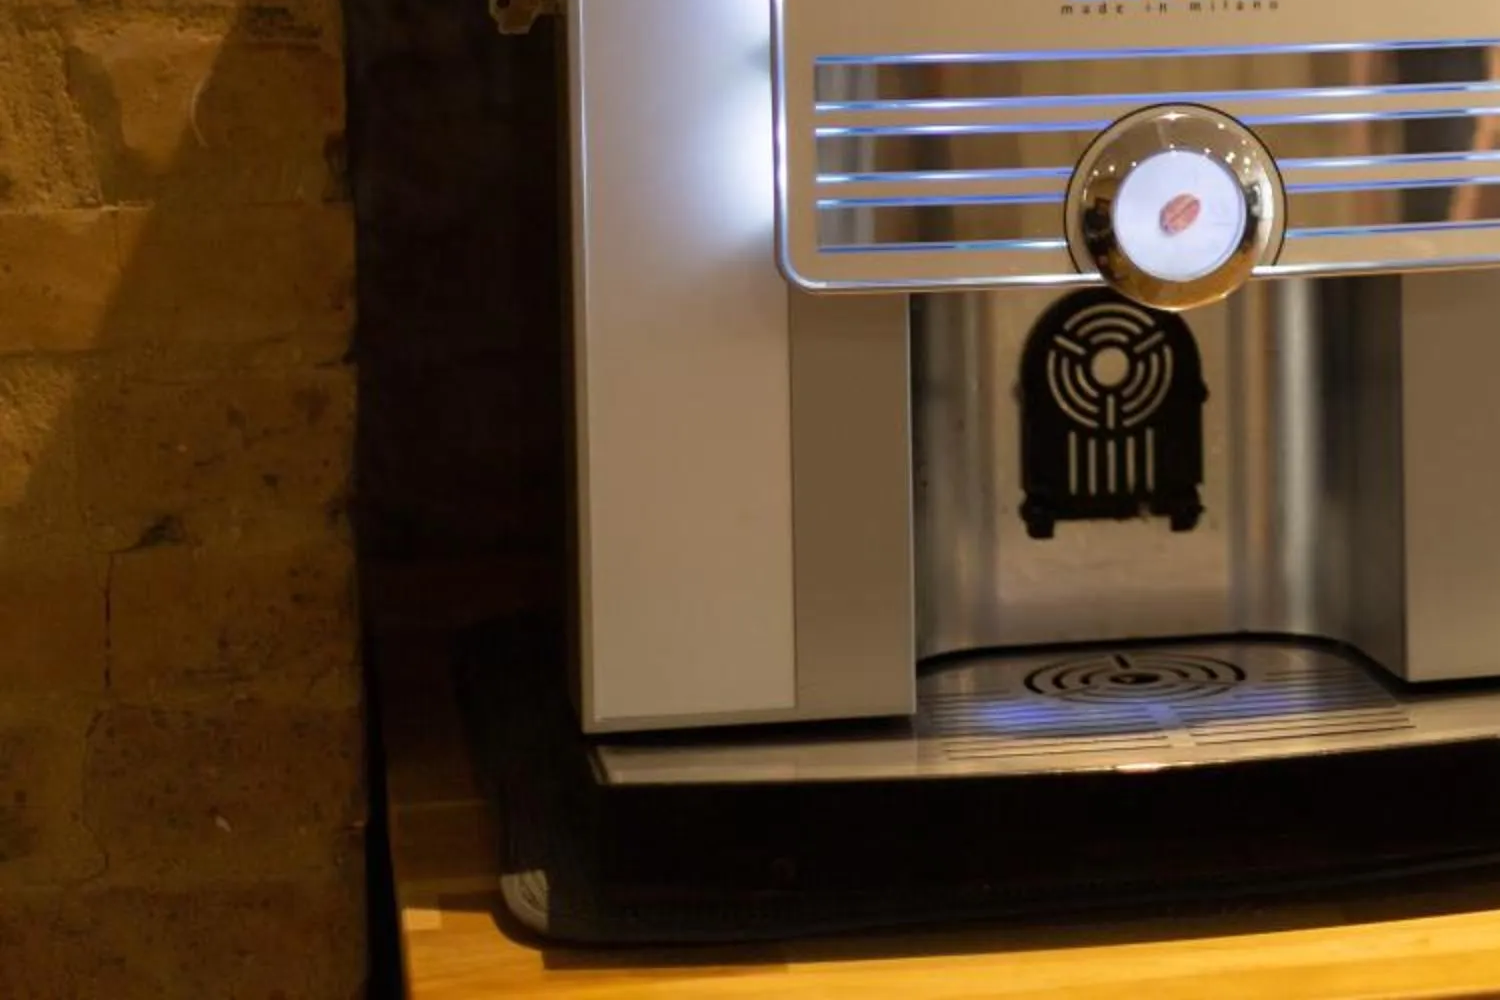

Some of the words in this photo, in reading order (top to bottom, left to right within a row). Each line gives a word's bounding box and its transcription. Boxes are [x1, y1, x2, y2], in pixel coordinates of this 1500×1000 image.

[1060, 2, 1124, 15] made
[1145, 1, 1168, 14] in
[1189, 0, 1279, 12] milano
